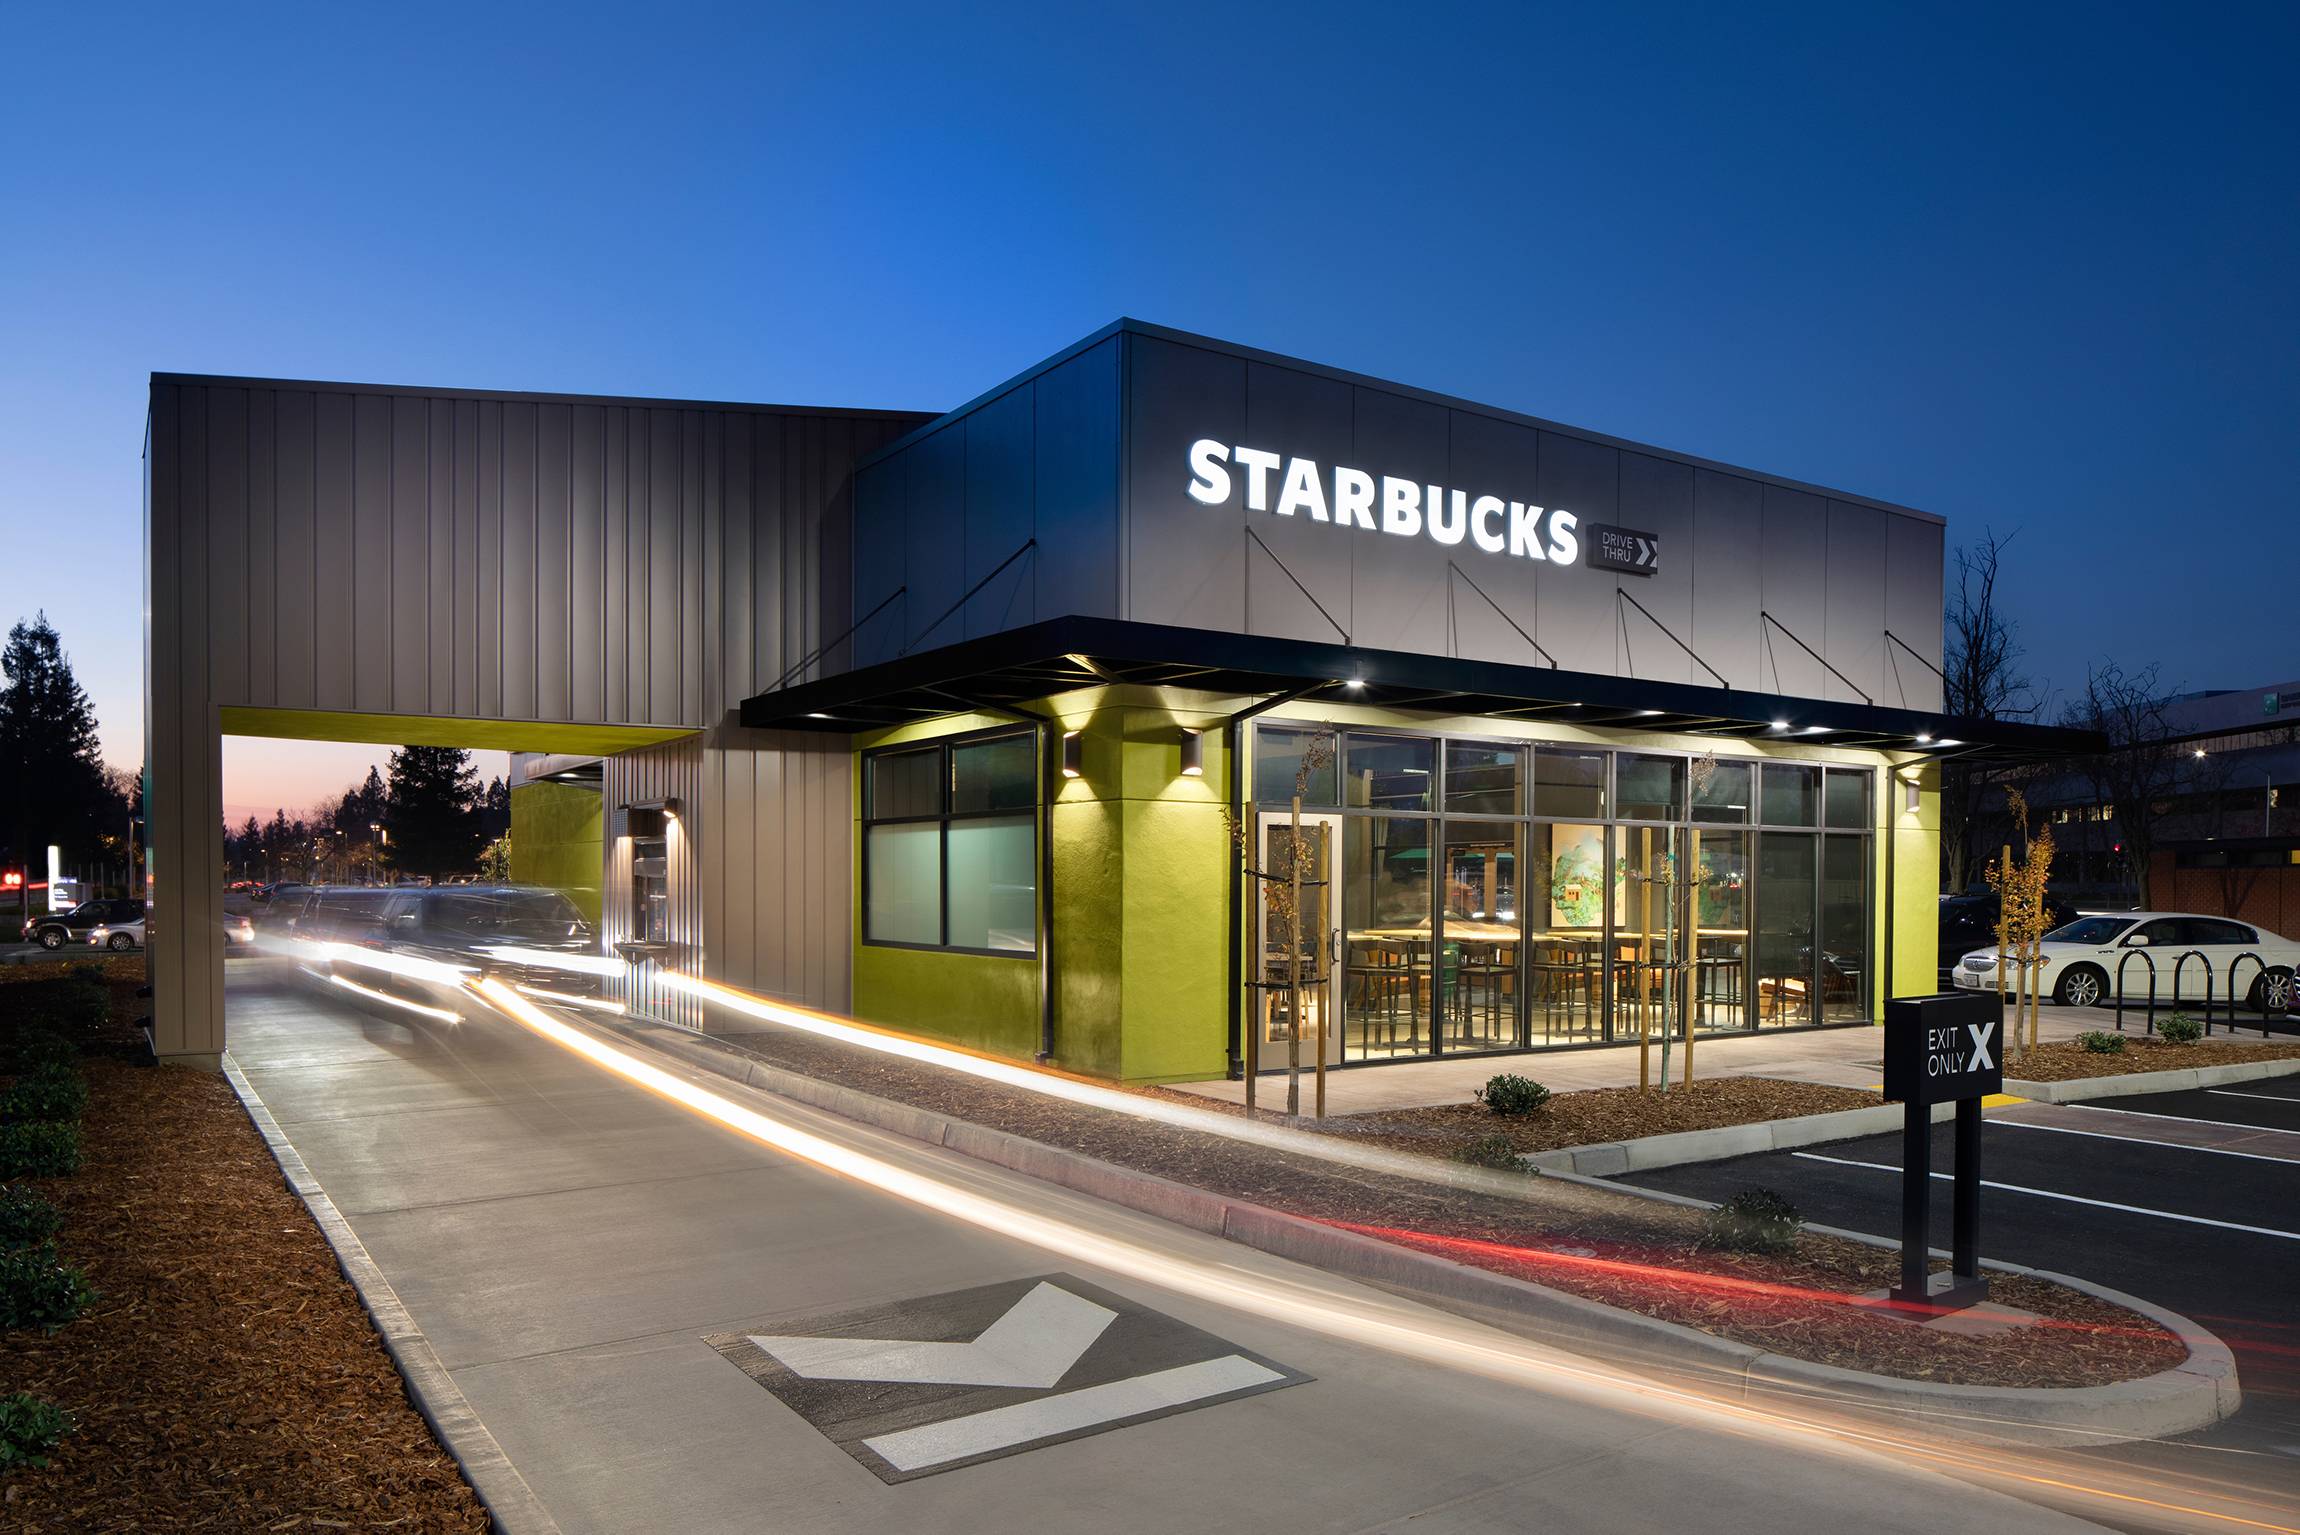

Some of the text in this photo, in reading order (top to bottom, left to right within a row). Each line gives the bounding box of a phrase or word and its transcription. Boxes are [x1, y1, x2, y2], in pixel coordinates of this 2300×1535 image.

[1187, 438, 1579, 566] STARBUCKS
[1602, 531, 1633, 549] DRIVE
[1602, 545, 1631, 562] THRU
[1928, 1026, 1958, 1051] EXIT
[1927, 1051, 1965, 1077] ONLY
